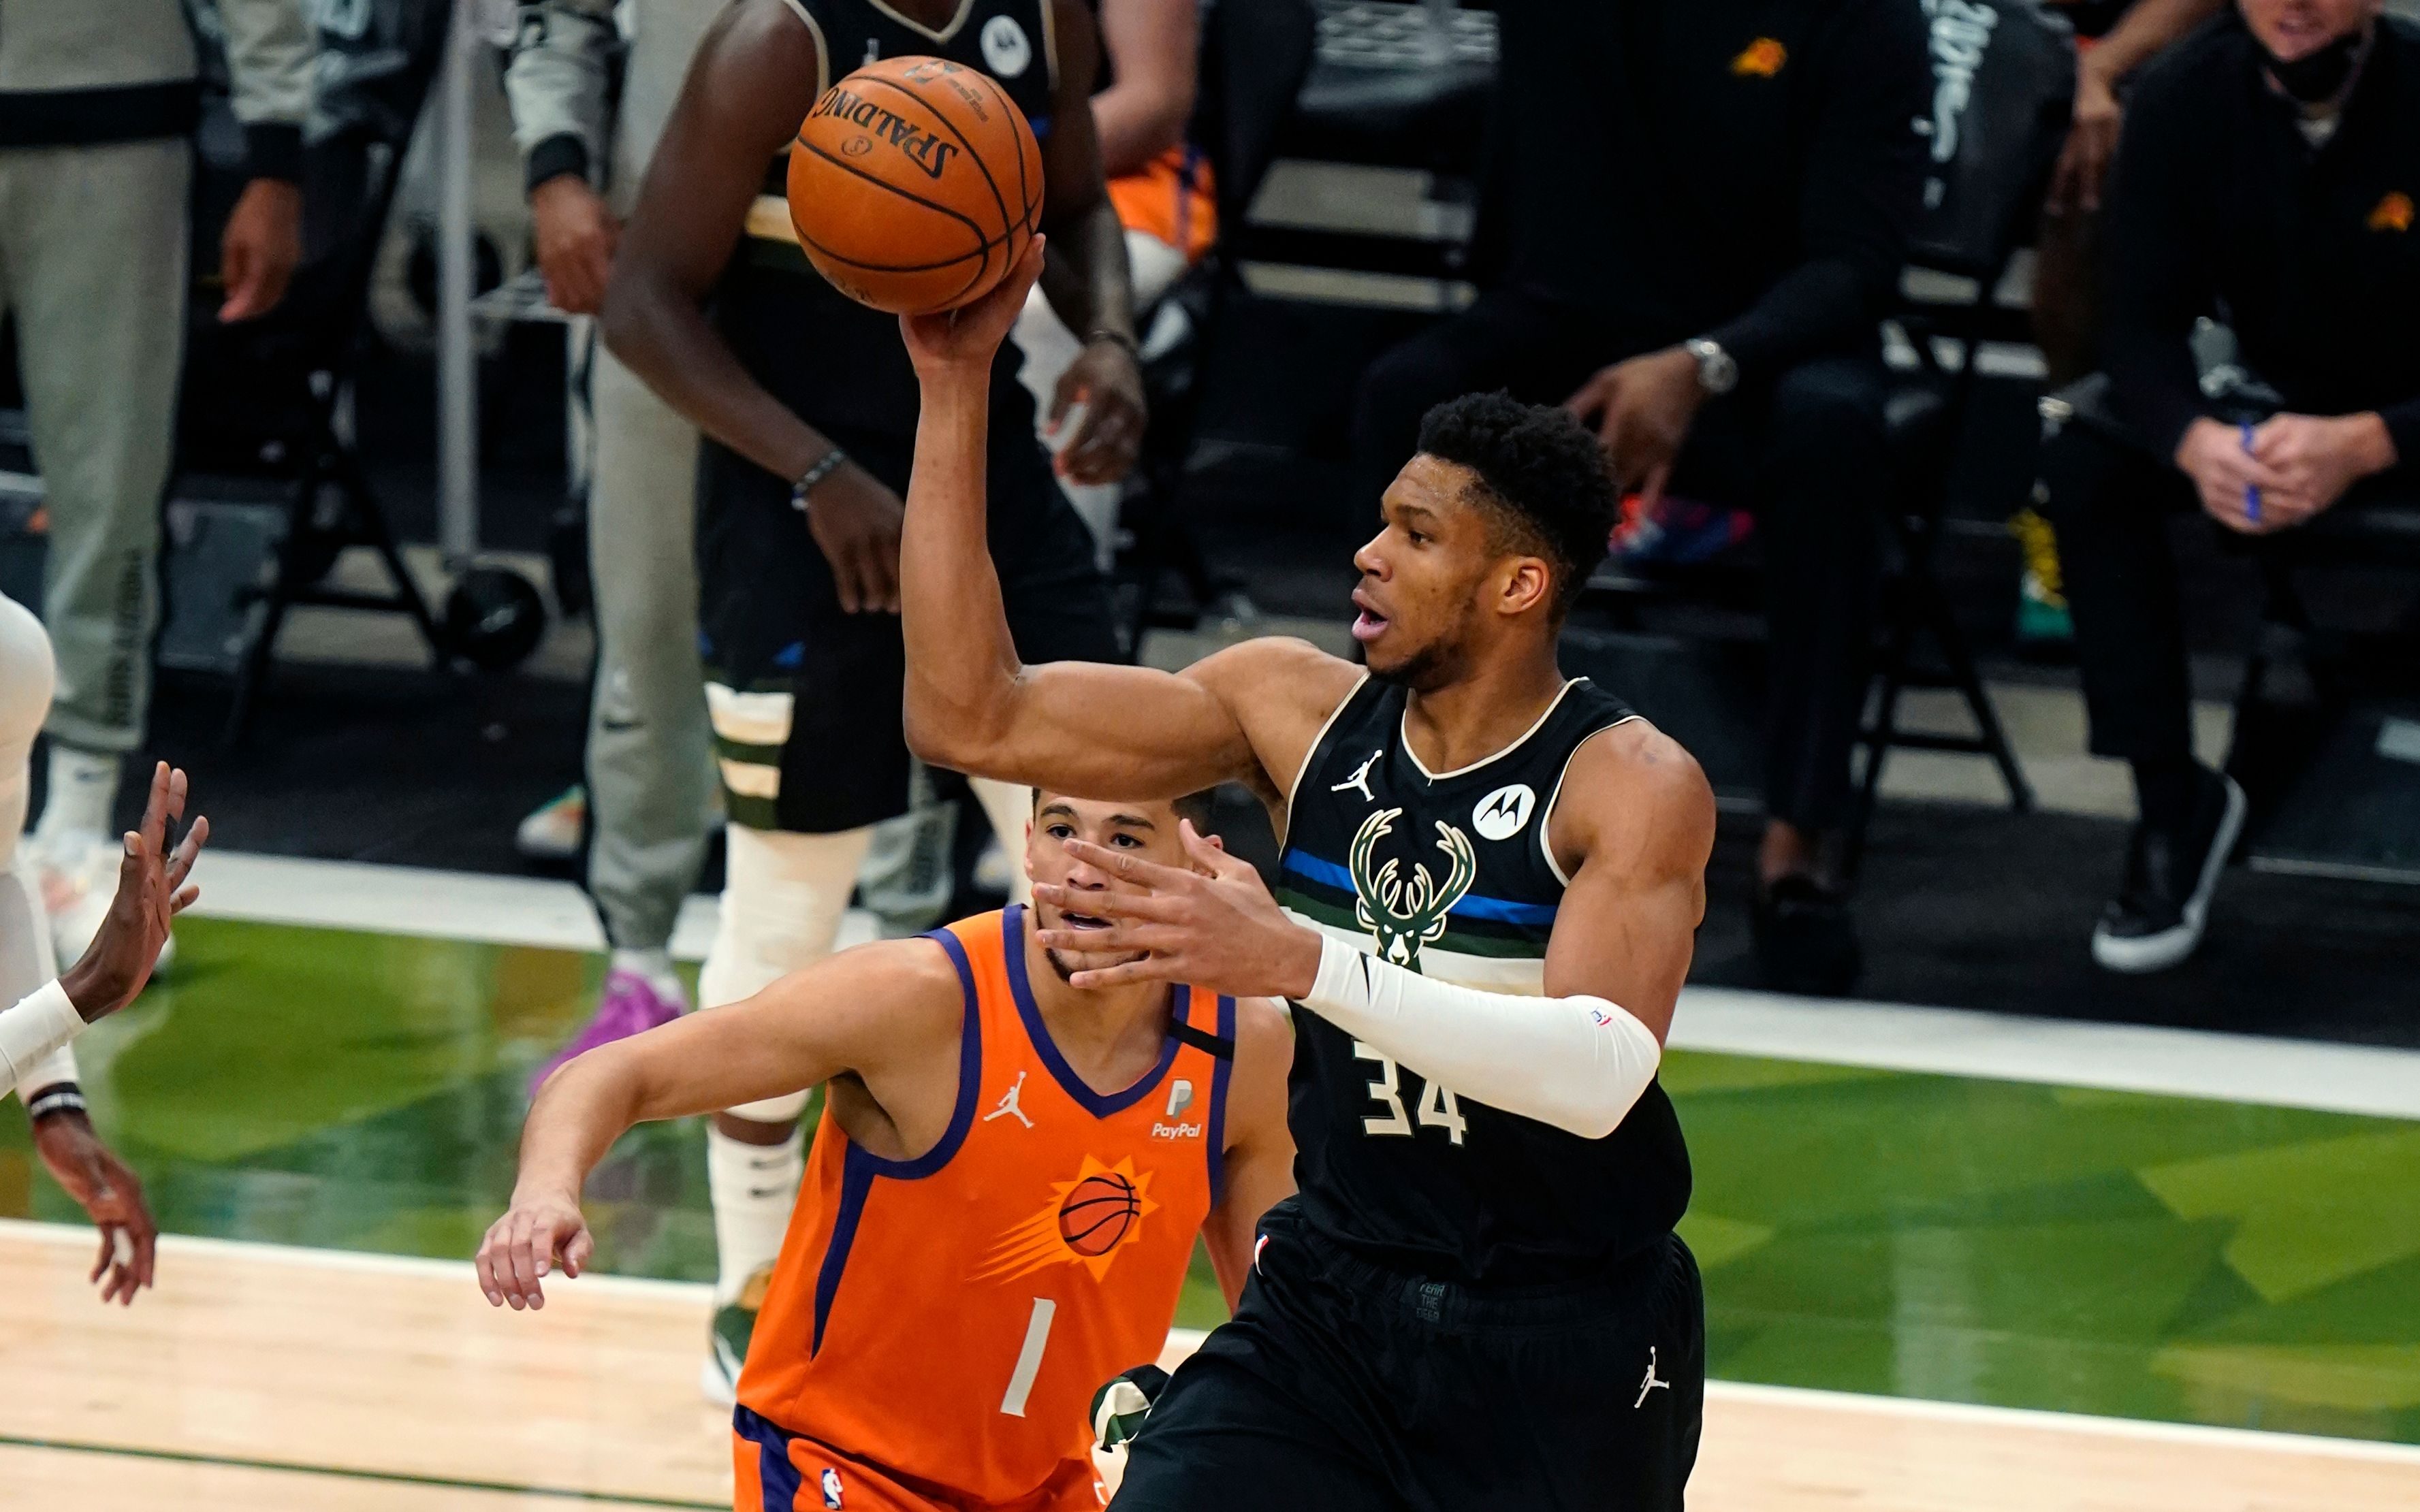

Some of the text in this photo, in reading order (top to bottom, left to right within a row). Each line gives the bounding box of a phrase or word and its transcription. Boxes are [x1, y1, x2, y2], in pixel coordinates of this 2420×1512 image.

[812, 86, 959, 179] SPALDING
[1151, 1123, 1201, 1140] PayPal
[1352, 1038, 1469, 1147] 34
[1000, 1297, 1057, 1417] 1
